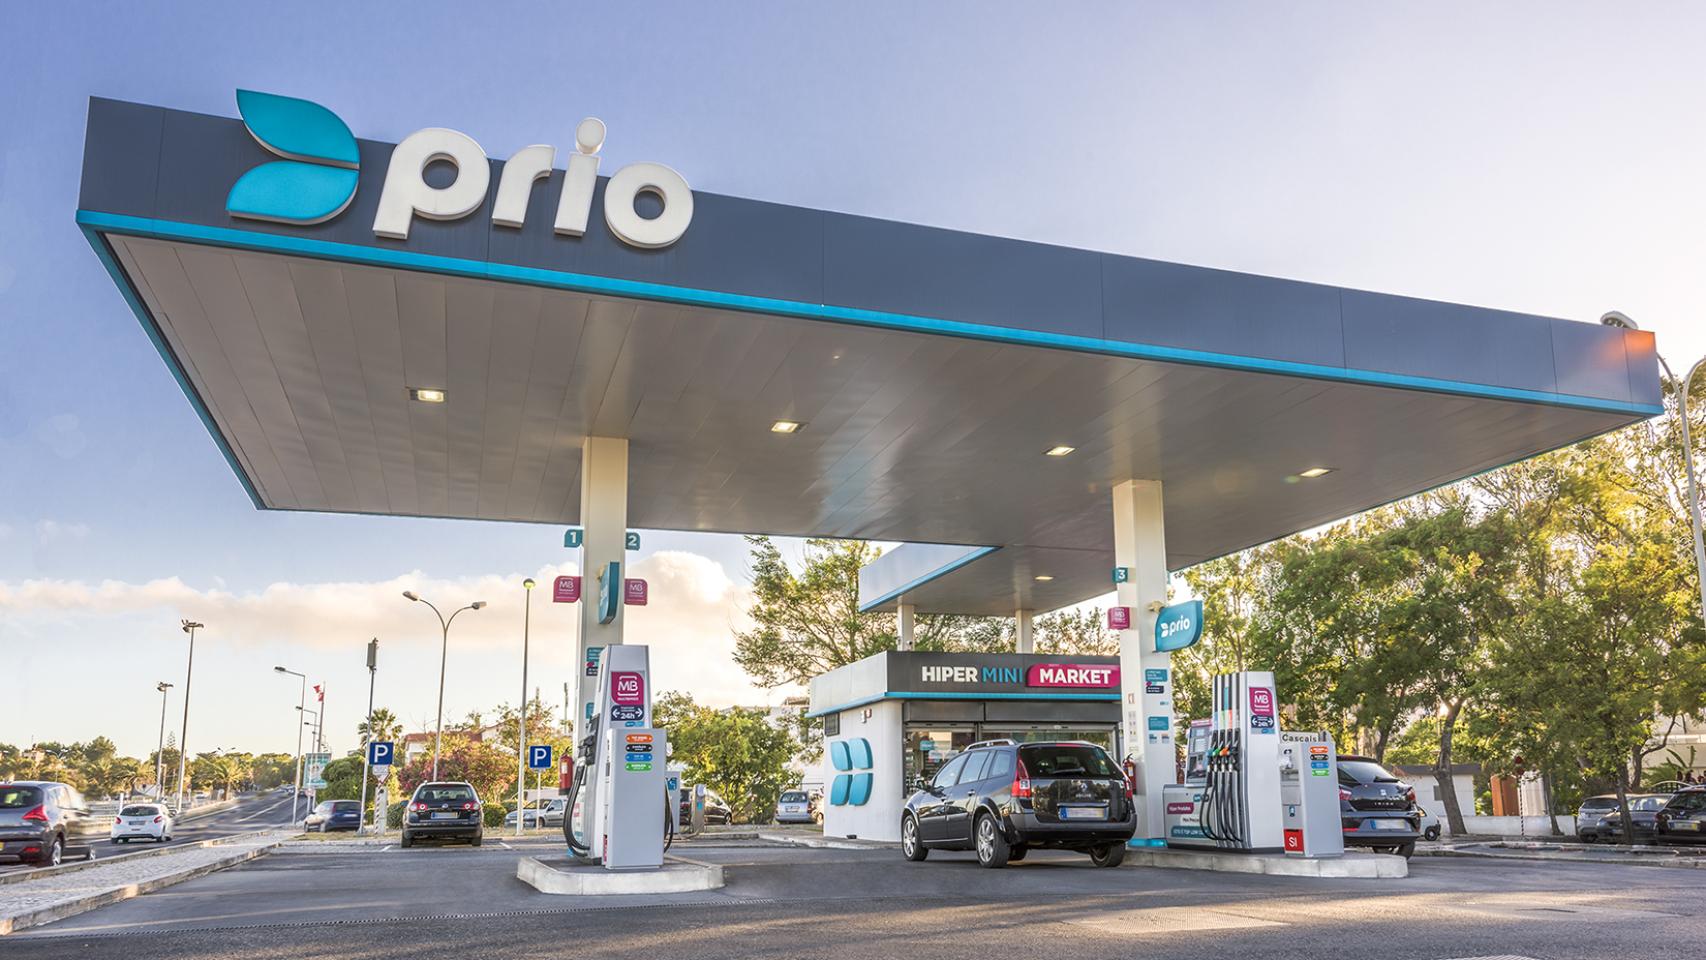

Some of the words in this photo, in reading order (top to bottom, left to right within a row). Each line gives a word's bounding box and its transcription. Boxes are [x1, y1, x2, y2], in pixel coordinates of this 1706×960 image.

[372, 117, 695, 249] prio
[569, 531, 577, 544] 1
[628, 535, 638, 546] 2
[1118, 569, 1126, 580] 3
[559, 580, 574, 589] MB
[629, 583, 643, 592] MB
[1169, 615, 1190, 637] prio
[921, 666, 978, 683] HIPER
[981, 667, 1023, 683] MINI
[1039, 668, 1112, 685] MARKET
[617, 681, 638, 692] MB
[1254, 694, 1269, 704] MB
[1282, 733, 1318, 742] Cascais
[373, 744, 389, 763] P
[533, 749, 547, 766] P
